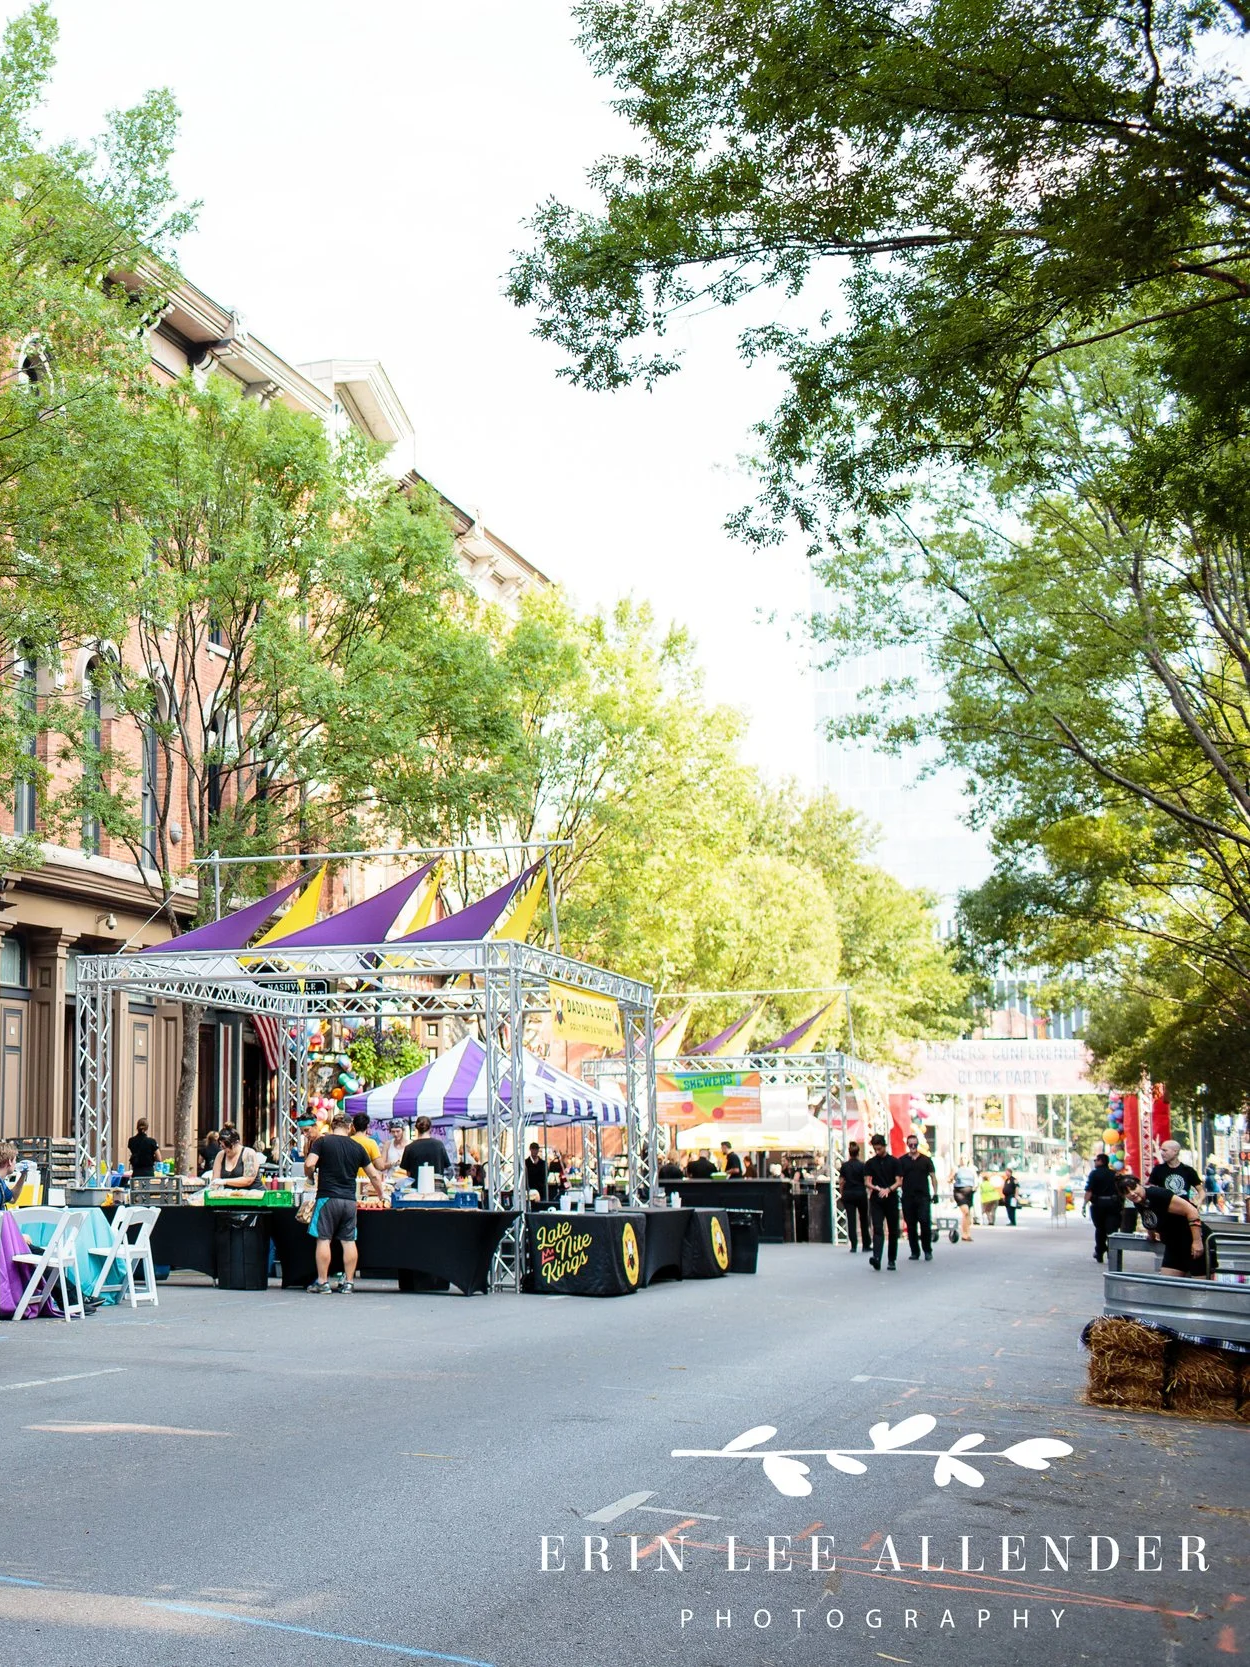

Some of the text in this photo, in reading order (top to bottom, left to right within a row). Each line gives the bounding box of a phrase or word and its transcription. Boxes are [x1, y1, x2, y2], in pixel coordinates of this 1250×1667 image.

[267, 982, 316, 992] NASHVILE
[567, 998, 612, 1022] DADDY'S DOGS
[683, 1073, 733, 1091] SKEWERS
[1005, 1069, 1052, 1085] PARTY
[536, 1221, 572, 1250] Late
[554, 1232, 593, 1259] Nite
[541, 1250, 589, 1284] Kings
